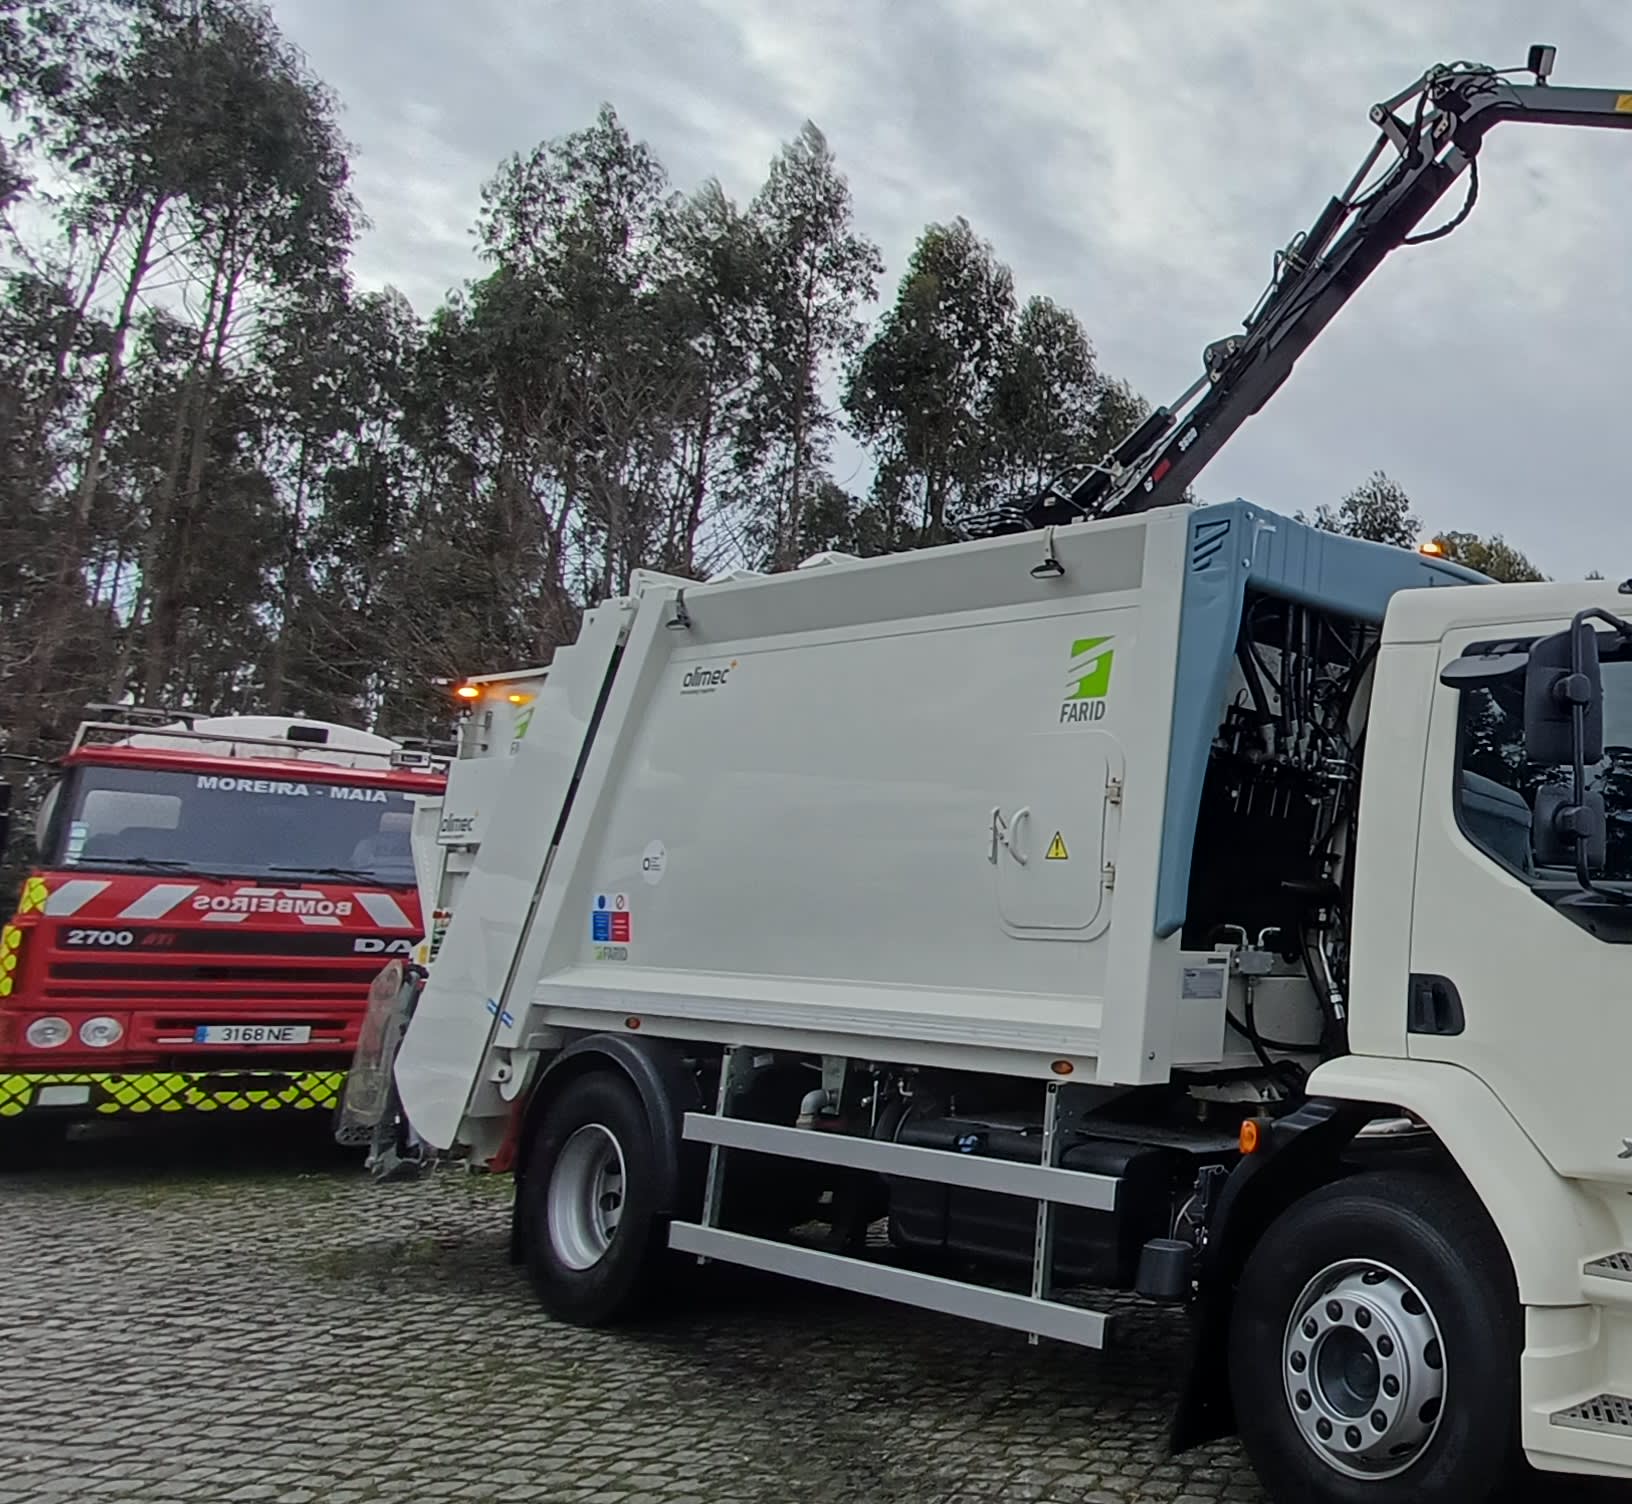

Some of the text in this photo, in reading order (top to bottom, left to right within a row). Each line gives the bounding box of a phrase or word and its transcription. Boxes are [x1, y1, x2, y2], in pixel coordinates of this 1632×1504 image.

[1060, 700, 1106, 723] FARID
[197, 776, 309, 796] MOREIRA
[330, 786, 388, 802] MAIA
[67, 930, 134, 945] 2700
[354, 938, 412, 953] DA
